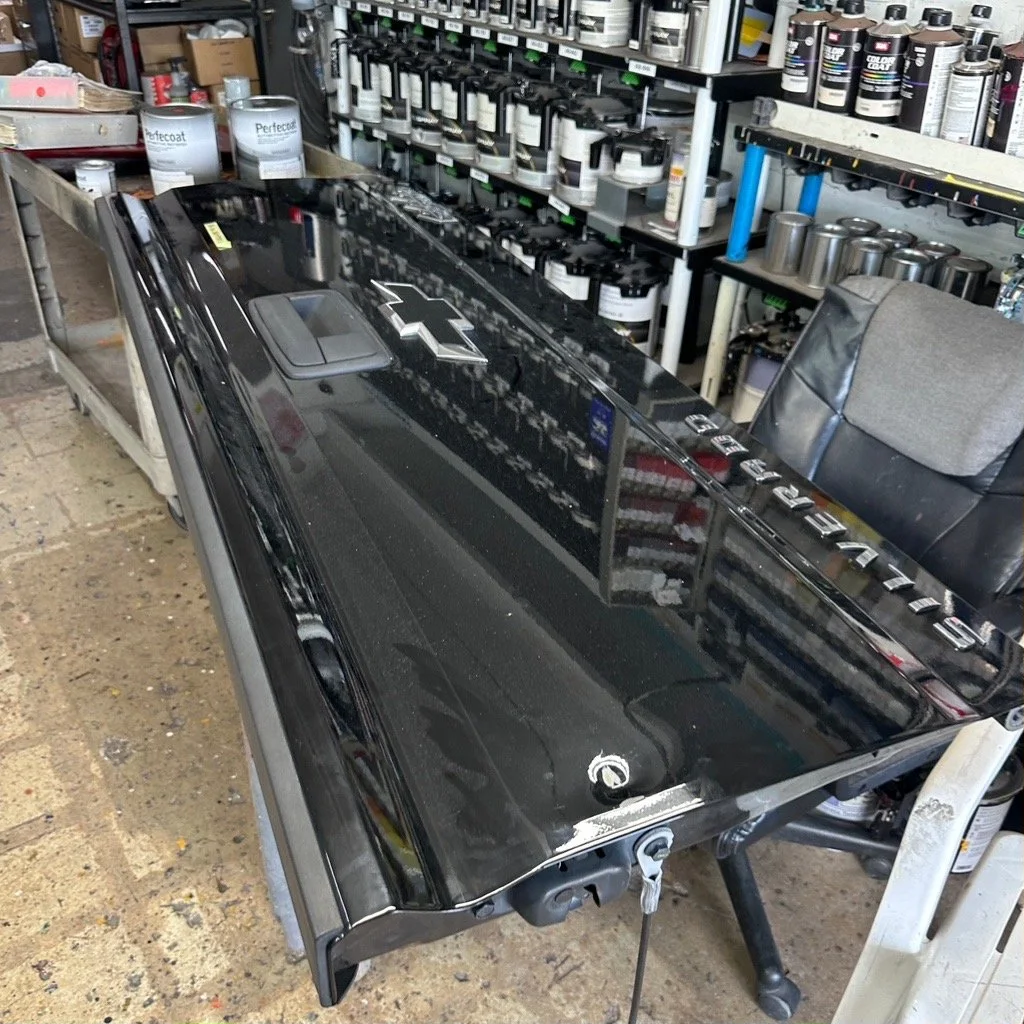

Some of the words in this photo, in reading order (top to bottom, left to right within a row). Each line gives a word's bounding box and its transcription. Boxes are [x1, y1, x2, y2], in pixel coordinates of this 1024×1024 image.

[866, 55, 896, 64] COLOR
[867, 62, 892, 71] COAT
[255, 118, 298, 134] Perfecoat
[145, 128, 187, 143] Perfecoat
[684, 413, 987, 651] SILVERADO
